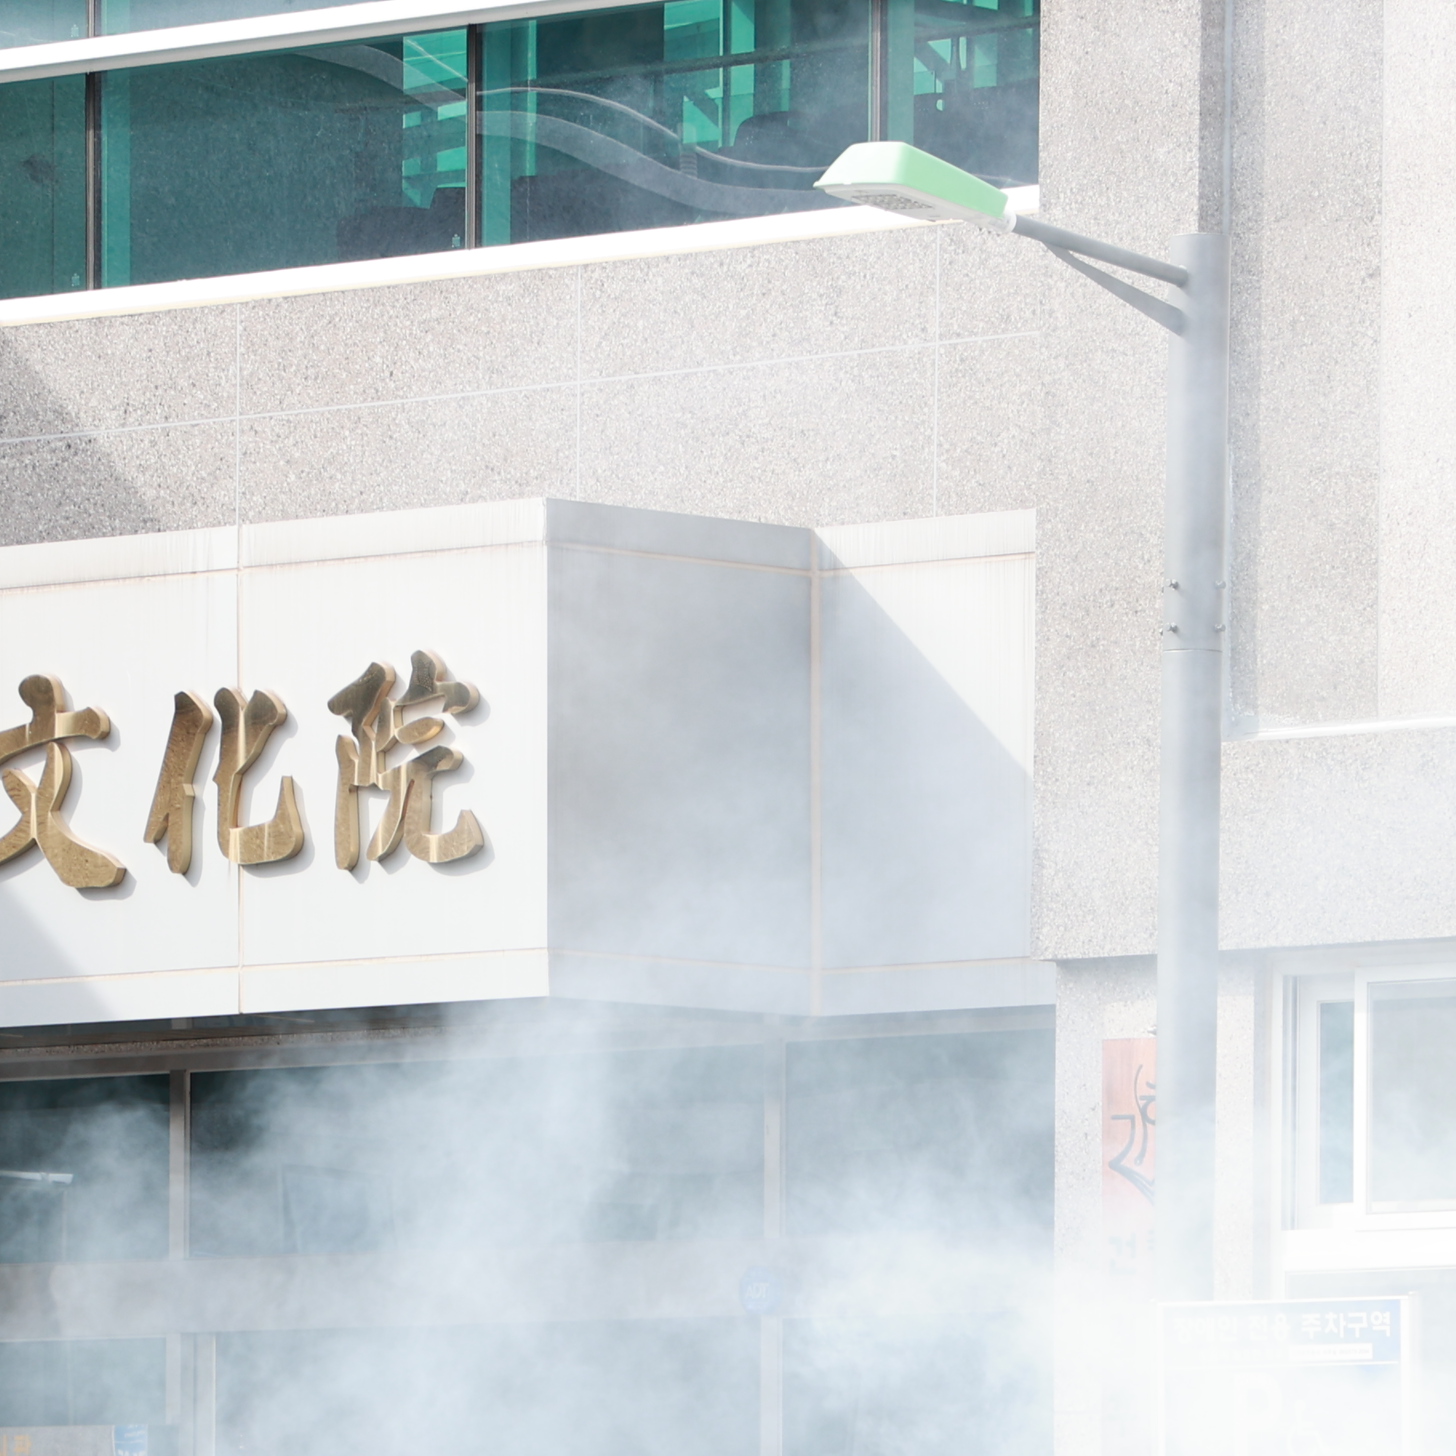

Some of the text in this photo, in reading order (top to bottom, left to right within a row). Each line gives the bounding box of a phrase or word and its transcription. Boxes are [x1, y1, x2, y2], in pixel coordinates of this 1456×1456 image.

[1172, 1310, 1392, 1344] 장애인 전용 주차구역
